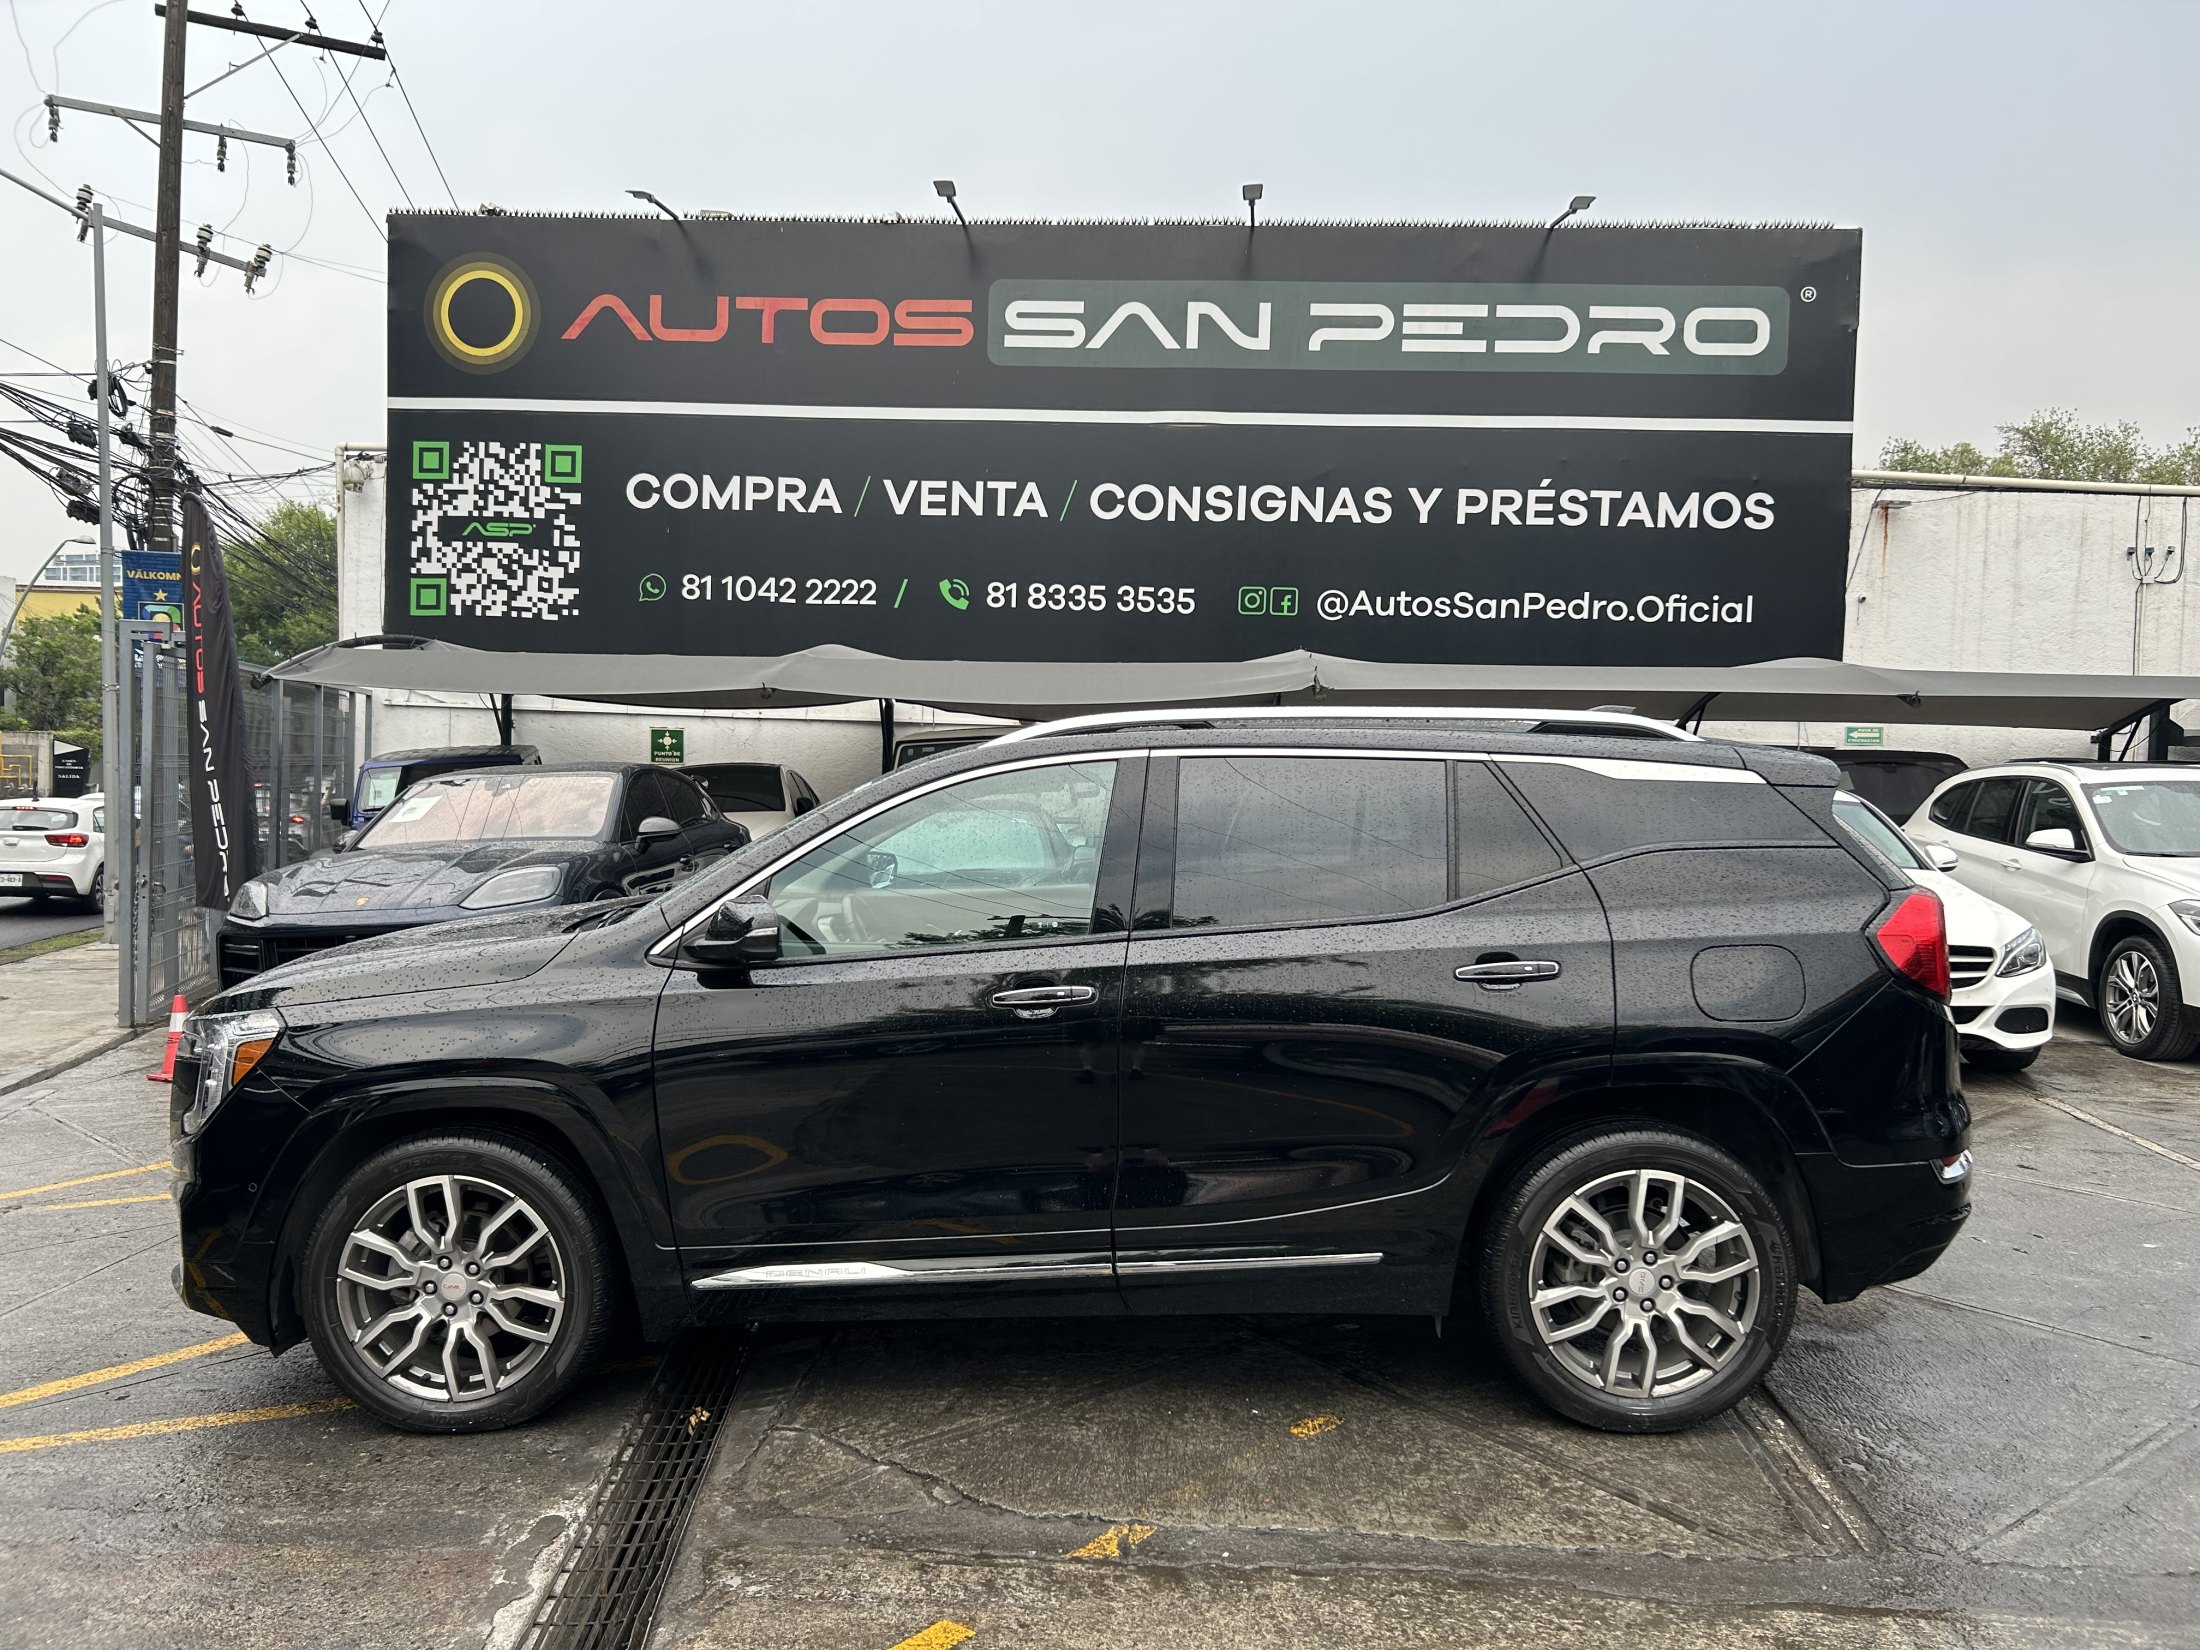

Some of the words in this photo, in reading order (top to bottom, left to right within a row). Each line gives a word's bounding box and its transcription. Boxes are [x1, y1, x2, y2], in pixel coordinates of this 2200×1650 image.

[561, 294, 974, 347] AUTOS
[1003, 301, 1272, 352] SAN
[1308, 303, 1771, 357] PEDRO
[625, 472, 843, 514] COMPRA
[882, 478, 1049, 518] VENTA
[1089, 482, 1393, 524] CONSIGNAS
[1407, 487, 1444, 524] Y
[1456, 478, 1775, 530] PRÉSTAMOS
[462, 521, 533, 537] ASP
[681, 573, 712, 601] 81
[721, 574, 797, 604] 1042
[805, 578, 877, 606] 2222
[986, 581, 1017, 609] 81
[1027, 582, 1107, 612] 8335
[1116, 584, 1196, 615] 3535
[1316, 589, 1754, 623] @AutosSanPedro.Oficial
[198, 700, 215, 772] SAN
[765, 1266, 867, 1279] DENALI
